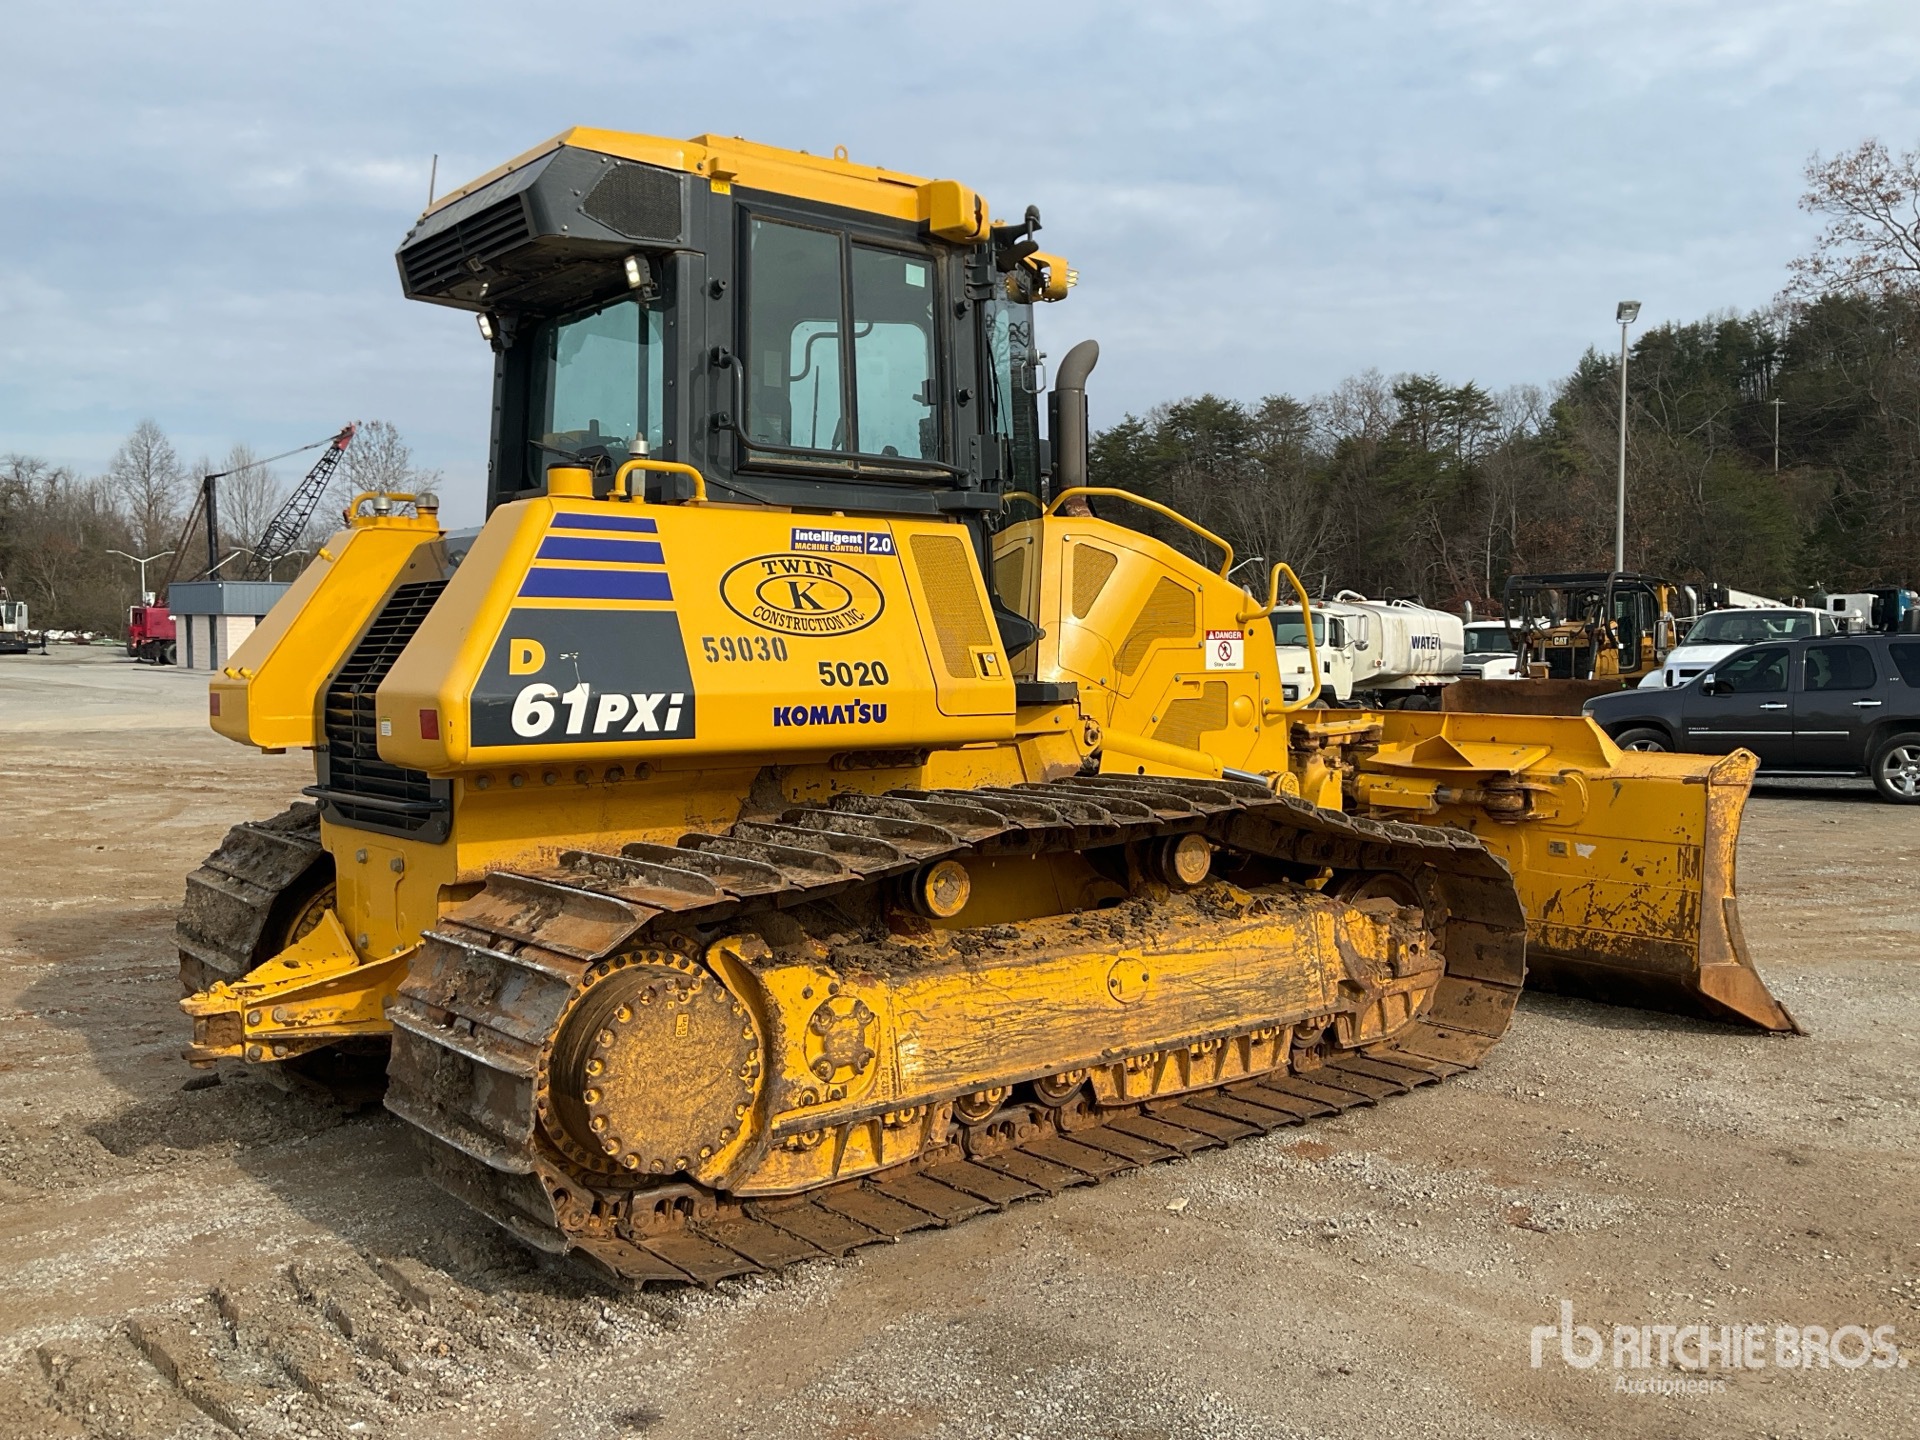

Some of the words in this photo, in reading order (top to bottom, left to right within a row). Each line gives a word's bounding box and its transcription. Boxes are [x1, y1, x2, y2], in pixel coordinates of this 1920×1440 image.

[794, 542, 829, 551] MACHINE
[830, 544, 863, 553] CONTROL
[869, 536, 891, 552] 2.0
[761, 559, 833, 578] TWIN
[785, 581, 826, 610] K
[752, 605, 845, 632] CONSTRUCTION
[844, 608, 866, 626] INC.
[1215, 631, 1242, 639] DANGER
[1554, 636, 1568, 646] CAT
[509, 638, 546, 675] D
[702, 636, 788, 663] 59030
[818, 661, 890, 687] 5020
[773, 698, 887, 727] KOMATSU
